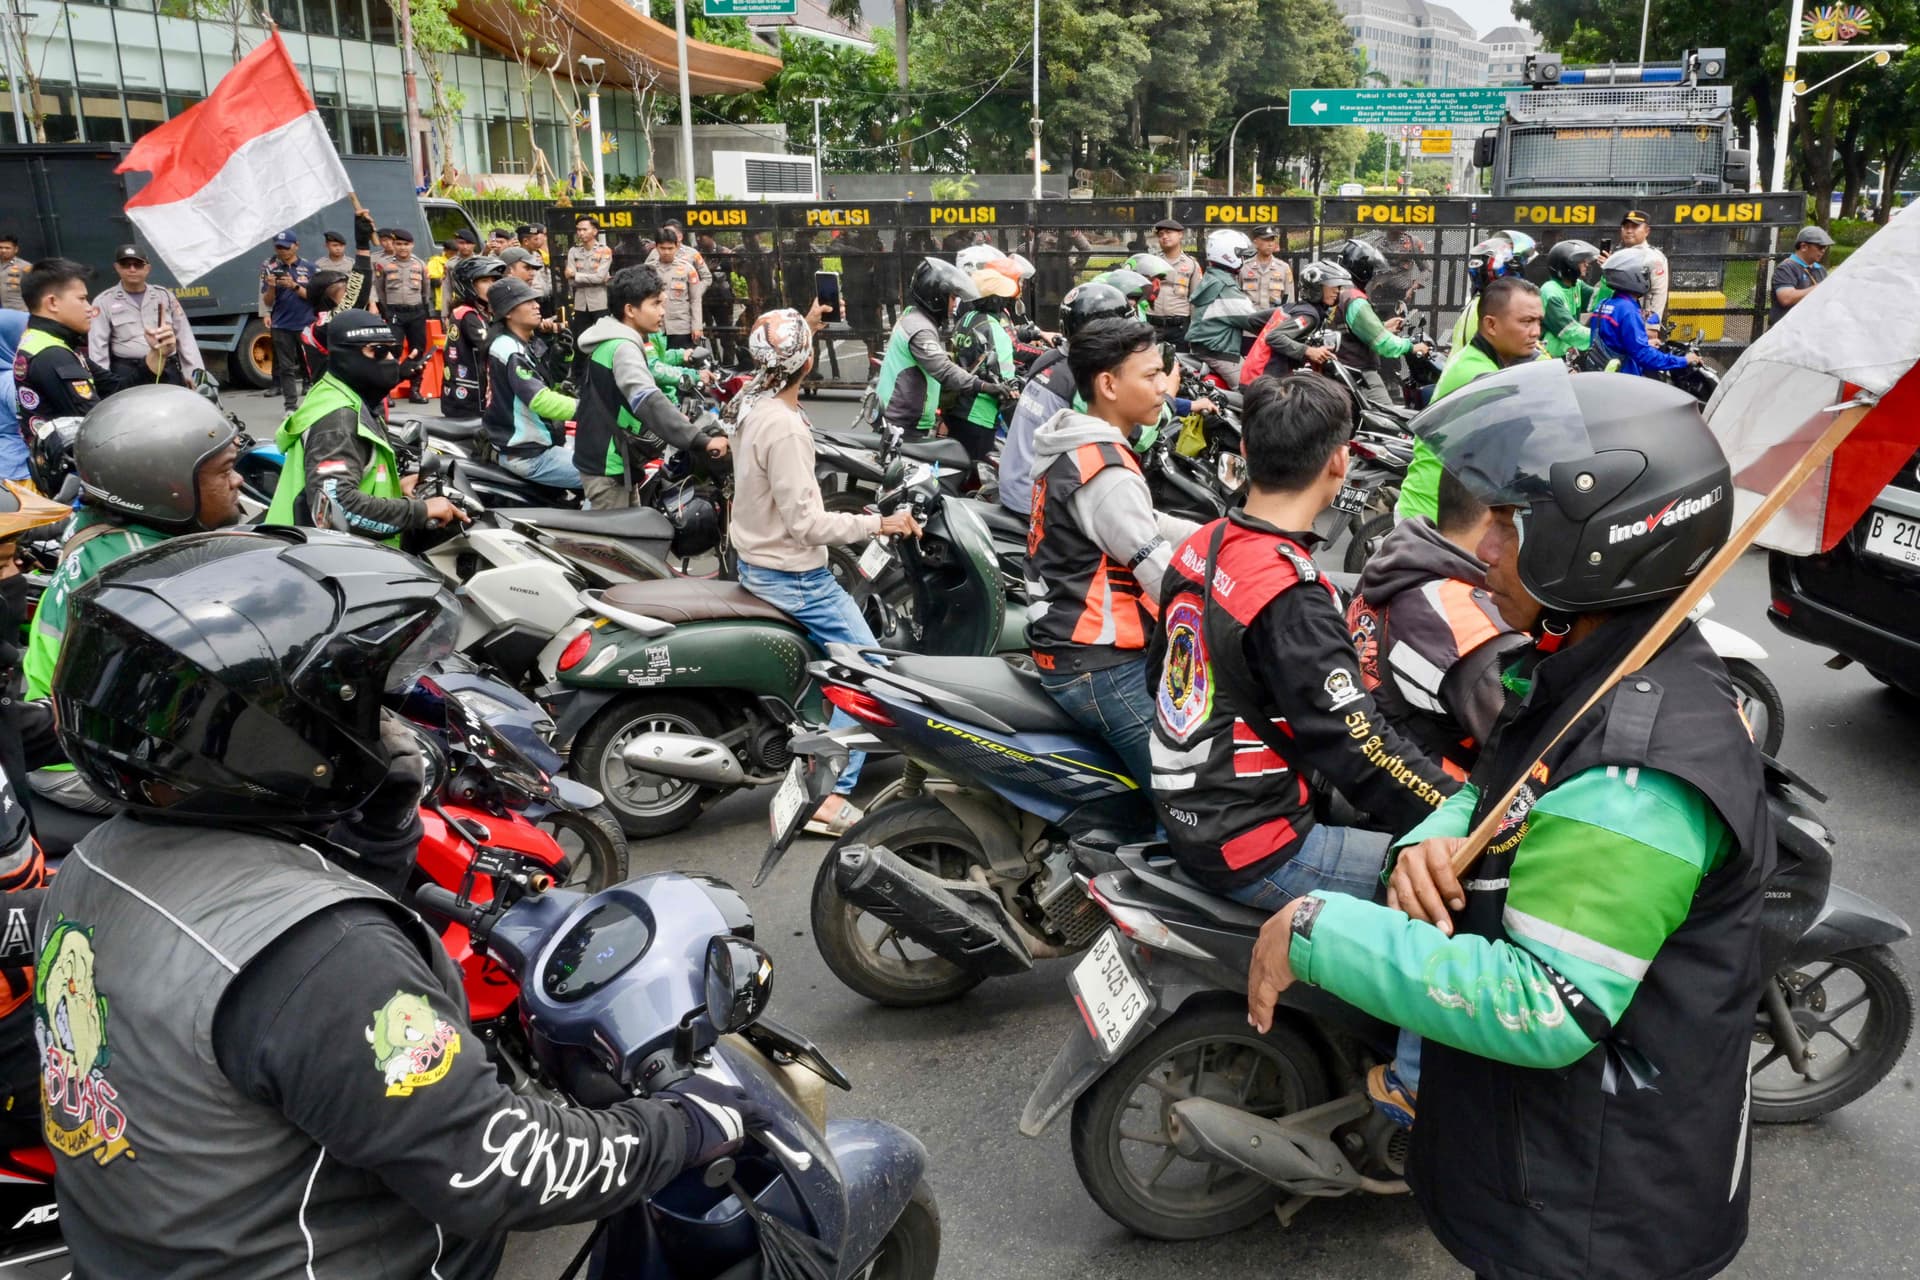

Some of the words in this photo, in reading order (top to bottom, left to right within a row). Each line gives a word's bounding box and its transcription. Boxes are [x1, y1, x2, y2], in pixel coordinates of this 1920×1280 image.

[575, 211, 633, 228] LISI
[686, 209, 748, 226] POLISI
[806, 208, 870, 226] POLISI
[930, 206, 996, 224] POLISI
[1205, 205, 1279, 223] POLISI
[1357, 205, 1435, 224] POLISI
[1514, 206, 1596, 225] POLISI
[1674, 203, 1762, 224] POLISI
[108, 495, 145, 511] Classic
[1871, 515, 1884, 538] B
[509, 586, 540, 596] HONDA
[617, 666, 703, 677] SCOOPY
[926, 718, 1007, 752] VARIO
[1093, 938, 1111, 962] AB
[1101, 954, 1129, 998] 5425
[45, 1044, 127, 1143] BUAS
